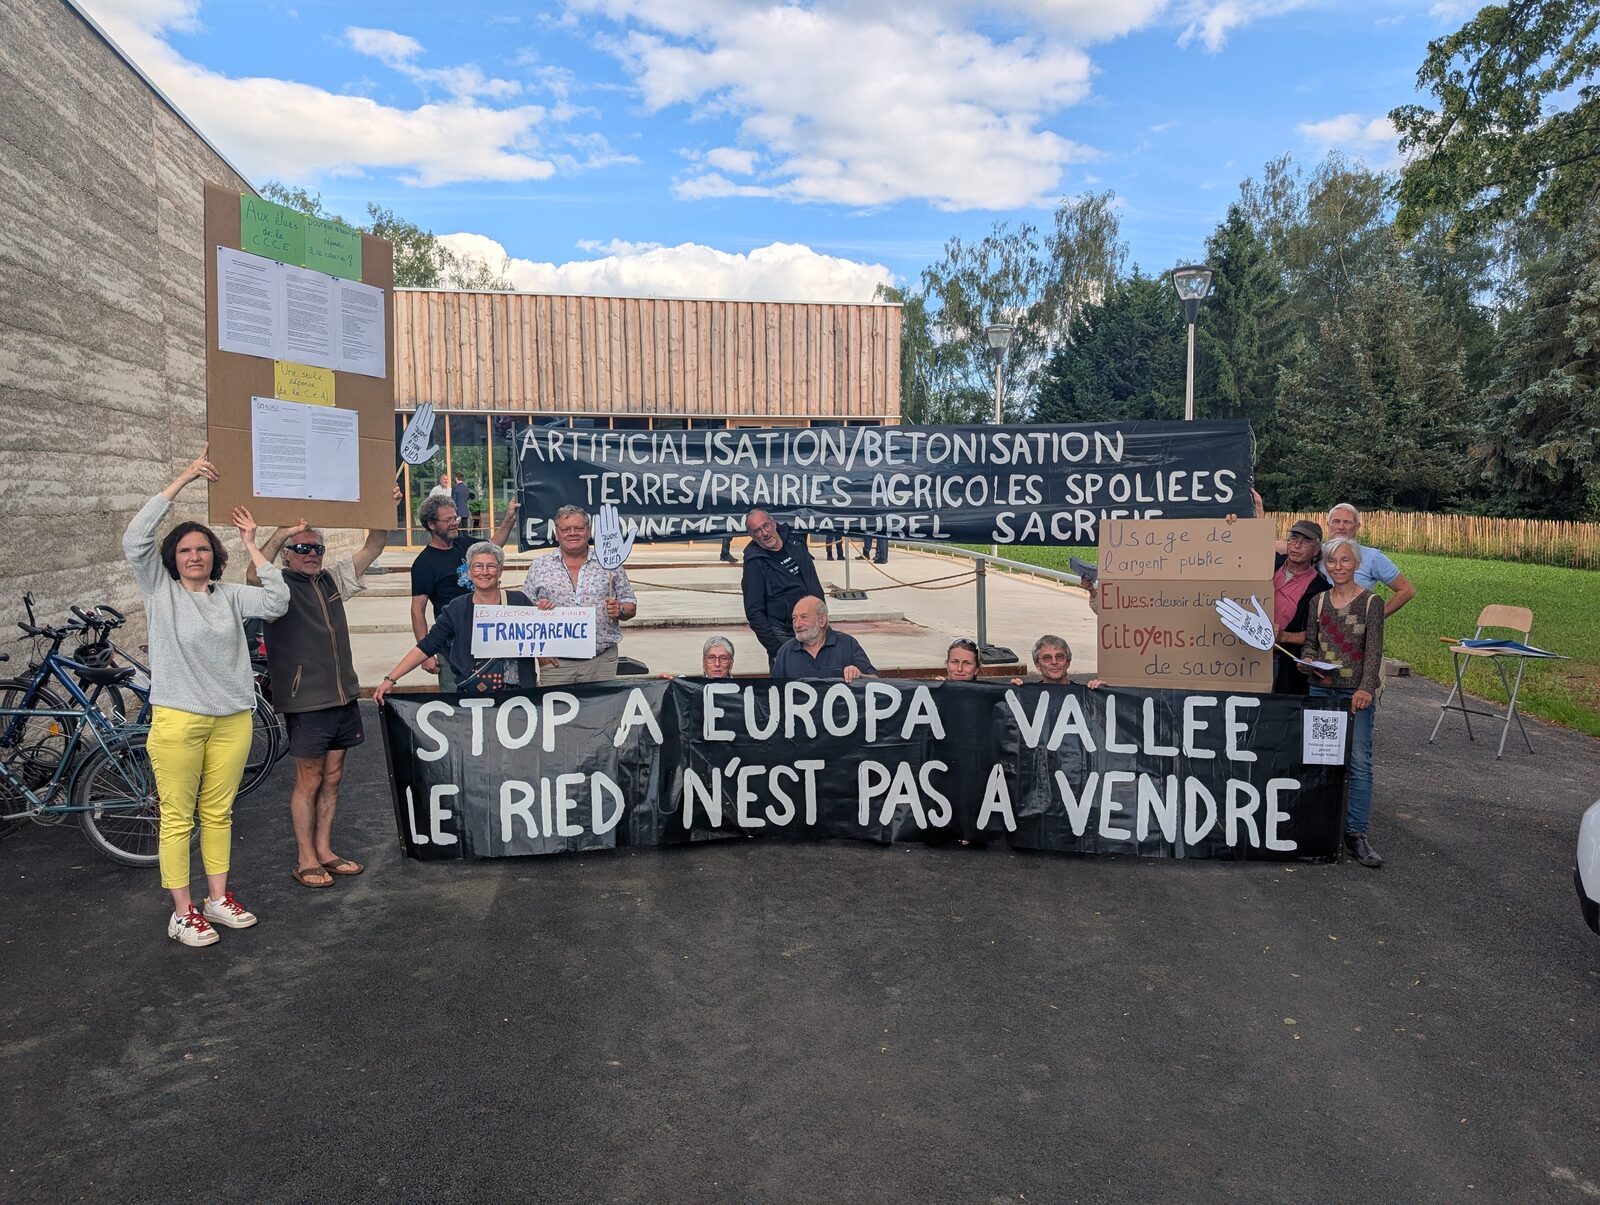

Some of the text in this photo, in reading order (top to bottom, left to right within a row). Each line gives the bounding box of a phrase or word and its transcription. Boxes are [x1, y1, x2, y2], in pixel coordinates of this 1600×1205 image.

[246, 199, 269, 223] Aux
[402, 445, 419, 462] RIED
[519, 426, 1124, 471] ARTIFICIALISATION/BETONISATION
[578, 469, 1237, 511] TERRES/PRAIRIES AGRICOLES SPOLIEES
[1108, 521, 1233, 553] Usage de
[603, 553, 622, 566] RIED
[1179, 551, 1224, 573] public
[475, 610, 490, 618] LES
[476, 622, 588, 642] TRANSPARENCE
[1195, 624, 1246, 647] dro
[1260, 627, 1272, 649] RIED
[1144, 654, 1261, 677] de savoir
[415, 682, 1261, 762] STOP A EUROPA VALLEE
[405, 756, 1301, 851] LE RIED N'EST PAS A VENDRE
